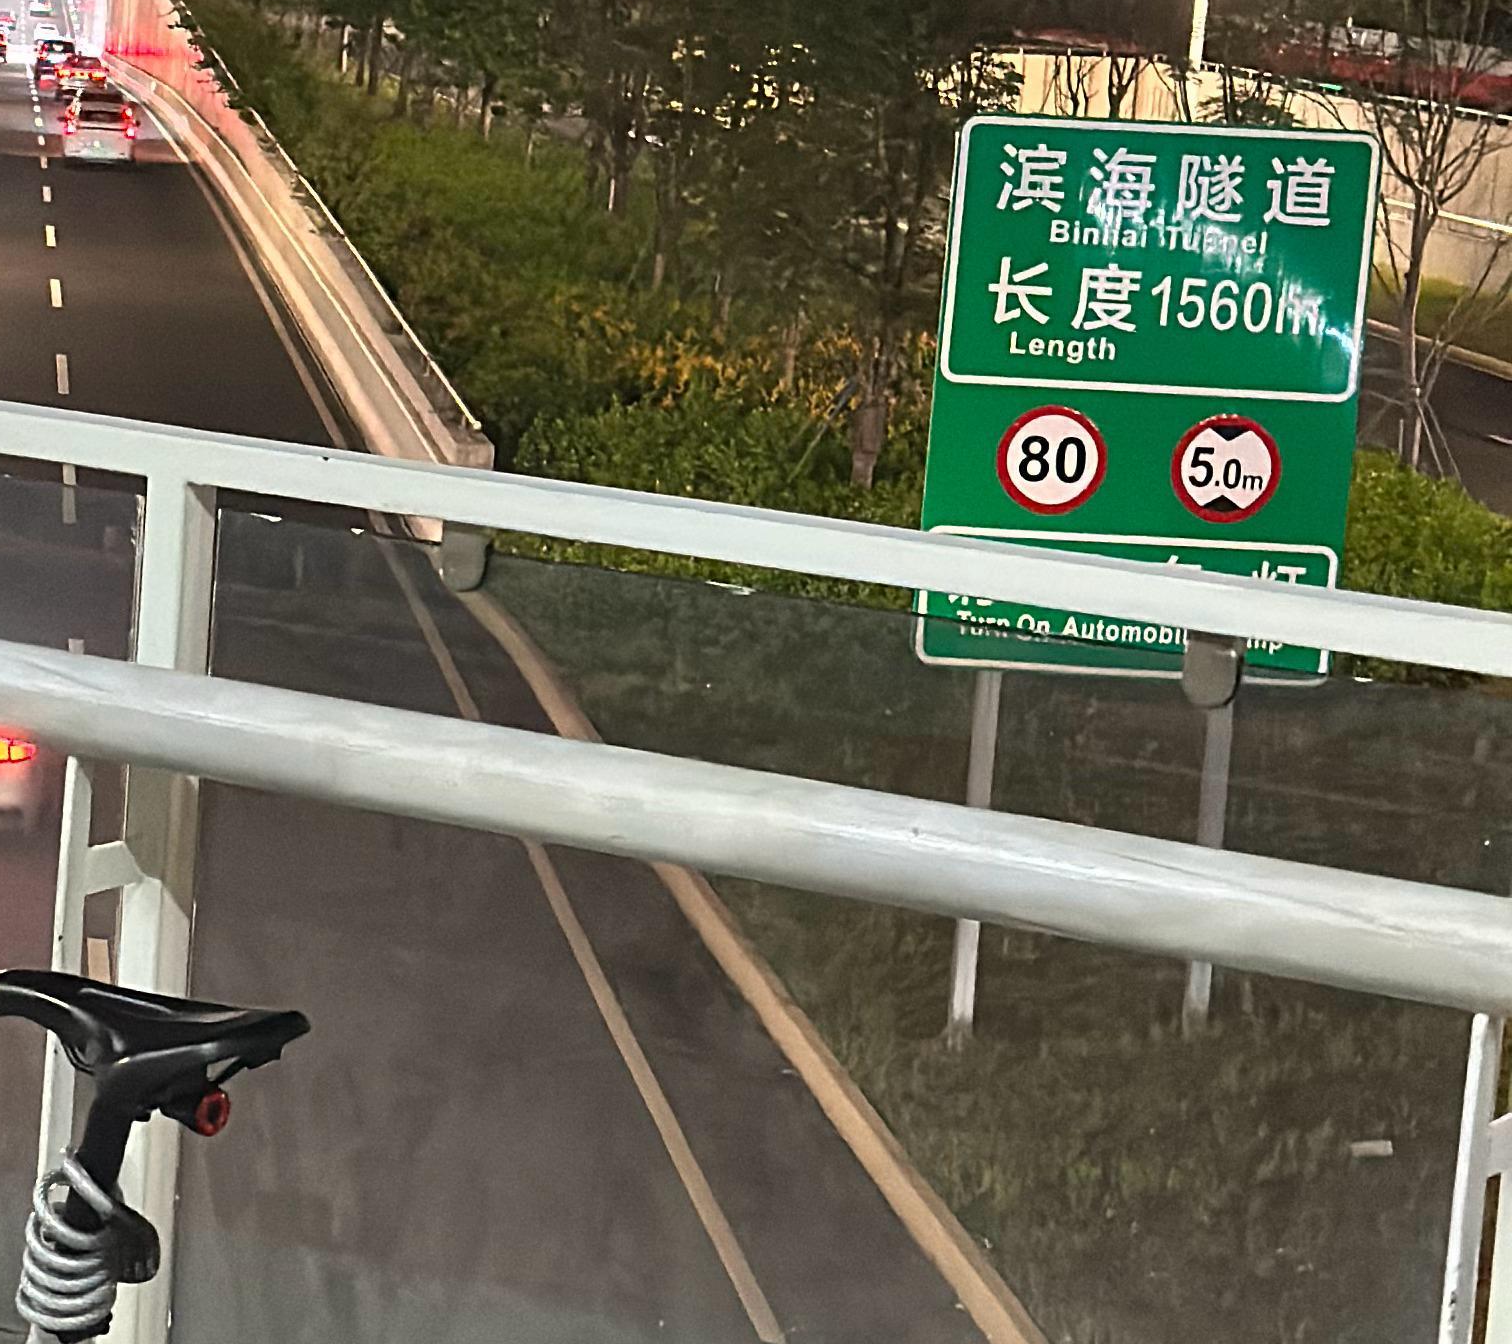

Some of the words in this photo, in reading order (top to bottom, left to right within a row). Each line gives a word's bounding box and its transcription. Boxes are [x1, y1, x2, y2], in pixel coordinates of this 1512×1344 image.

[996, 143, 1335, 227] 滨海隧道
[1009, 330, 1117, 364] Length
[1018, 435, 1087, 484] 80
[1188, 446, 1264, 491] 5.0m
[1061, 615, 1189, 647] Automobil
